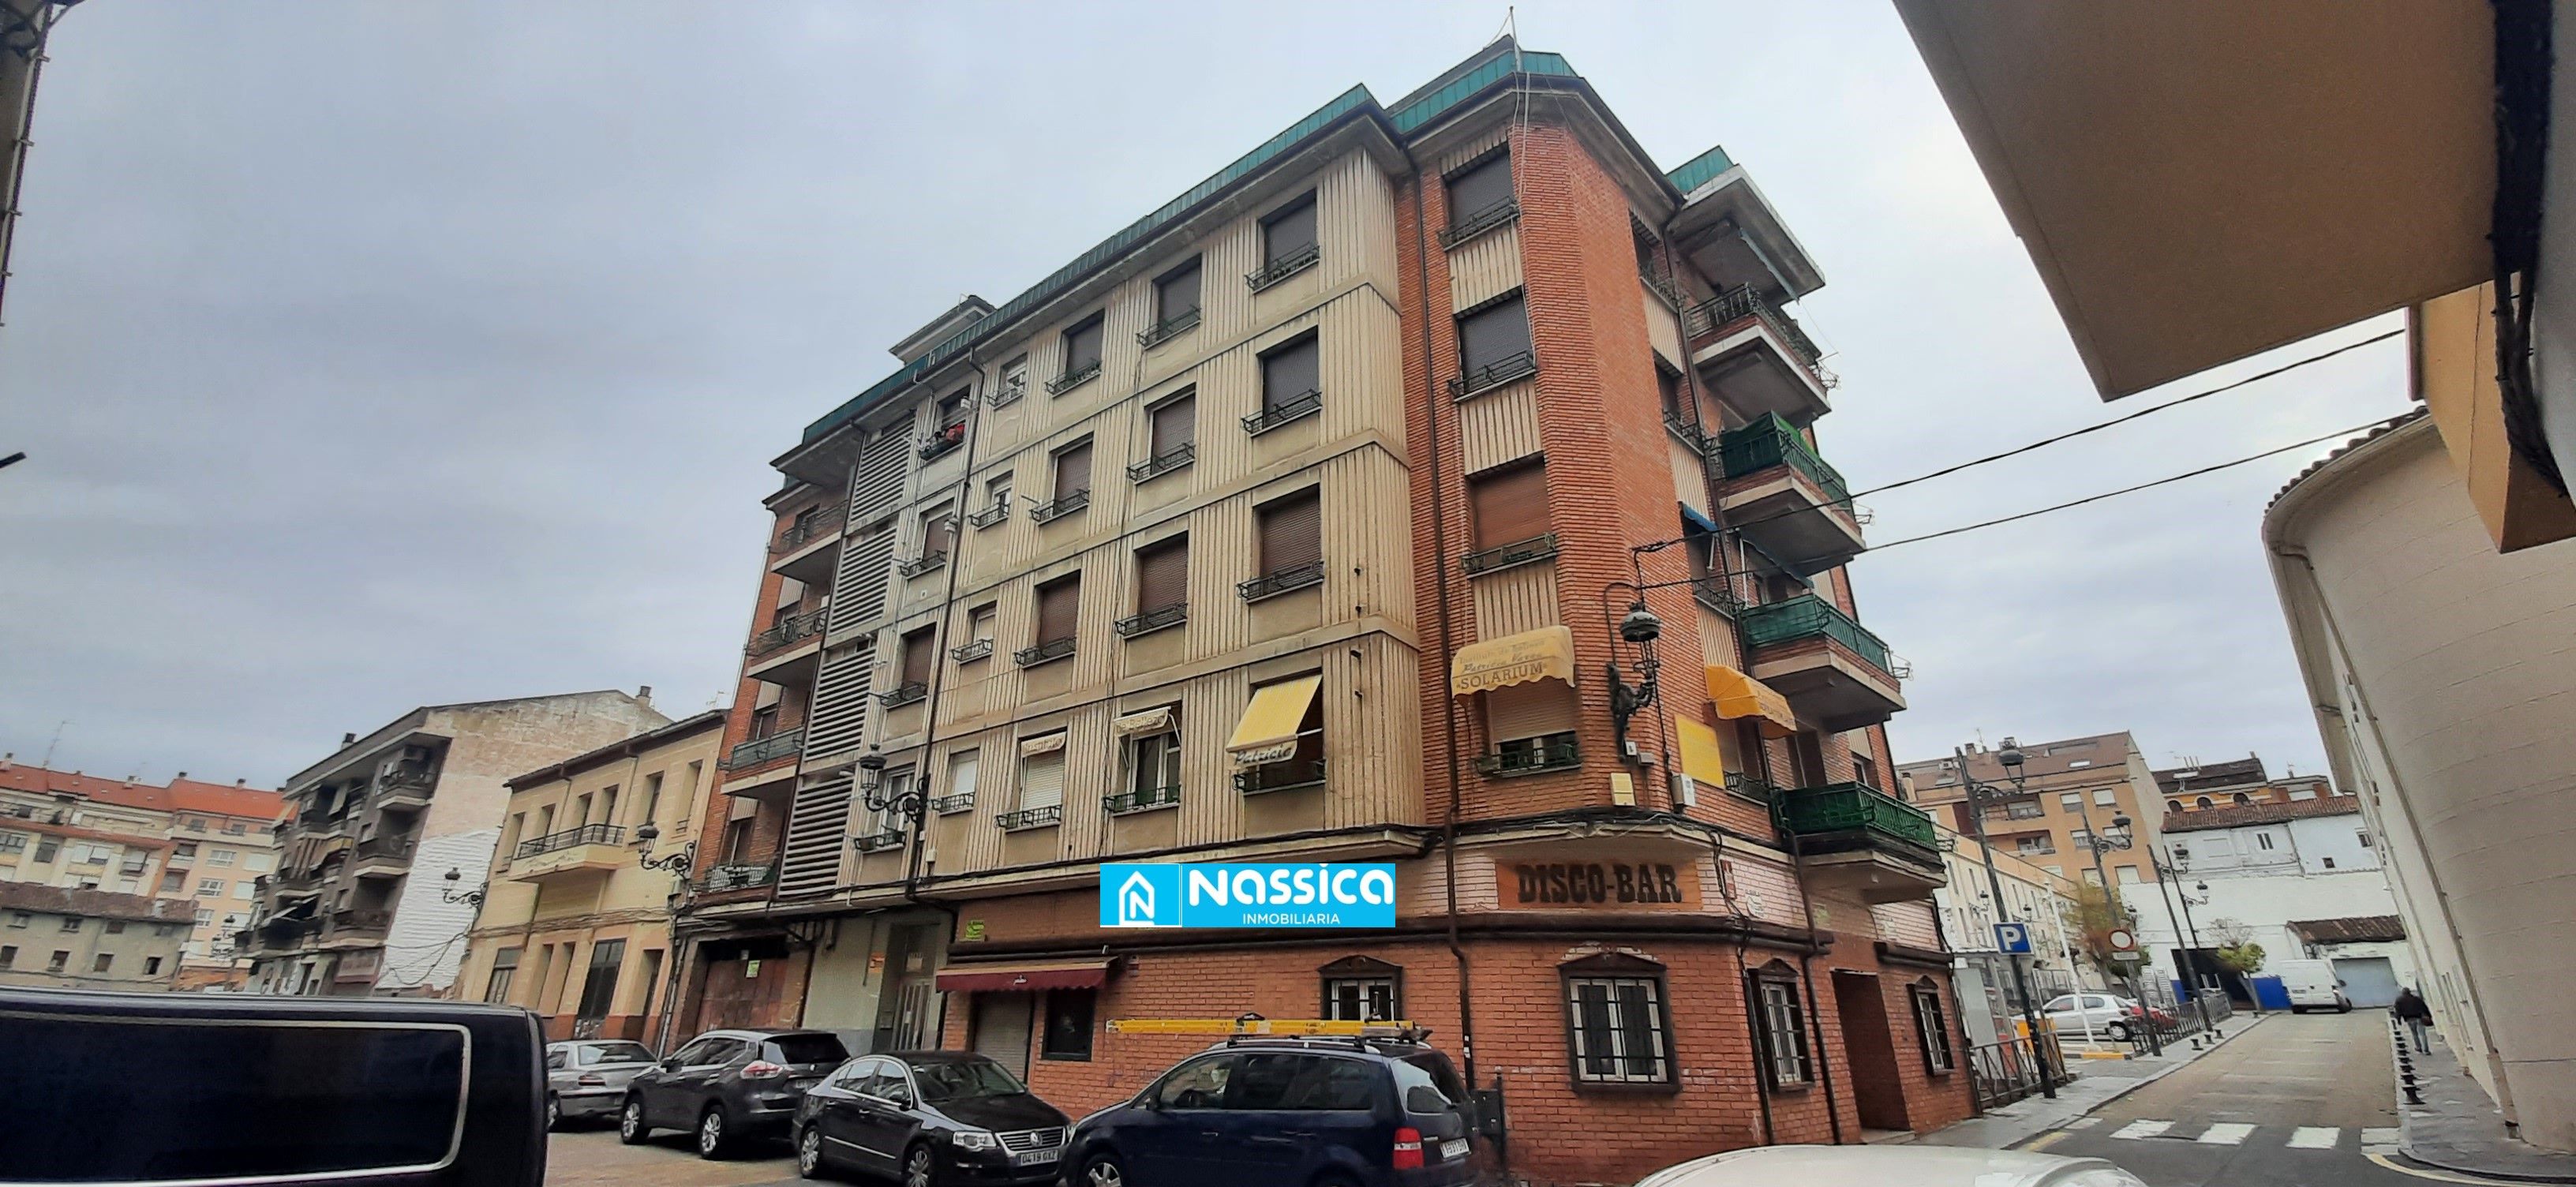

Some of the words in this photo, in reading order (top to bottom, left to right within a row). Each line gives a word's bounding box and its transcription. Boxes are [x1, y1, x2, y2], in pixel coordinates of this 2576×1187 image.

[1234, 743, 1293, 766] Patricia
[1517, 863, 1683, 904] DISCO-BAR
[1999, 925, 2022, 951] P
